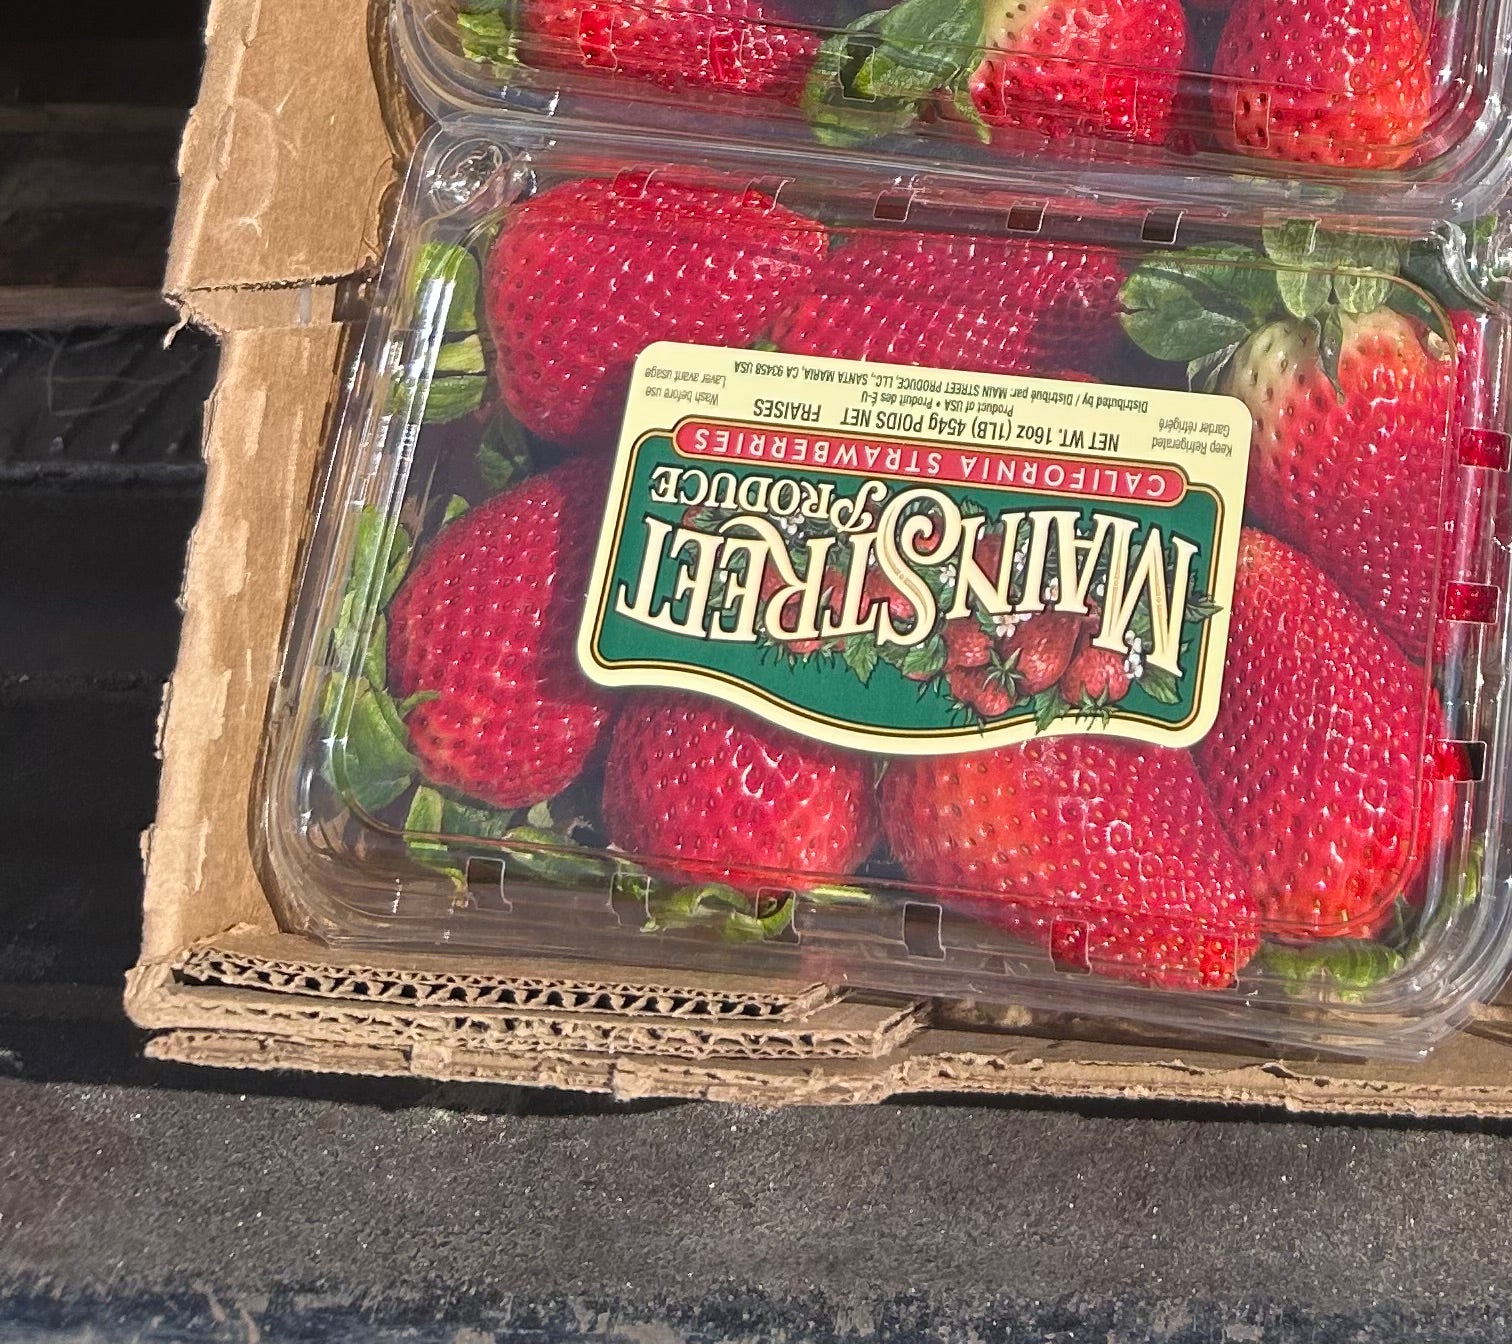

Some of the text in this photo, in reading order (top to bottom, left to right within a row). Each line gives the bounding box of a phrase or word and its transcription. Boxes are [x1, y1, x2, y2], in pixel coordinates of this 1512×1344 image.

[751, 398, 1120, 452] NET WT. 16oz (1LB) 454g POIDS NET FRAISES
[692, 428, 1169, 497] CALIFORNIA STRAWBERRIES
[647, 466, 884, 532] PRODUCE
